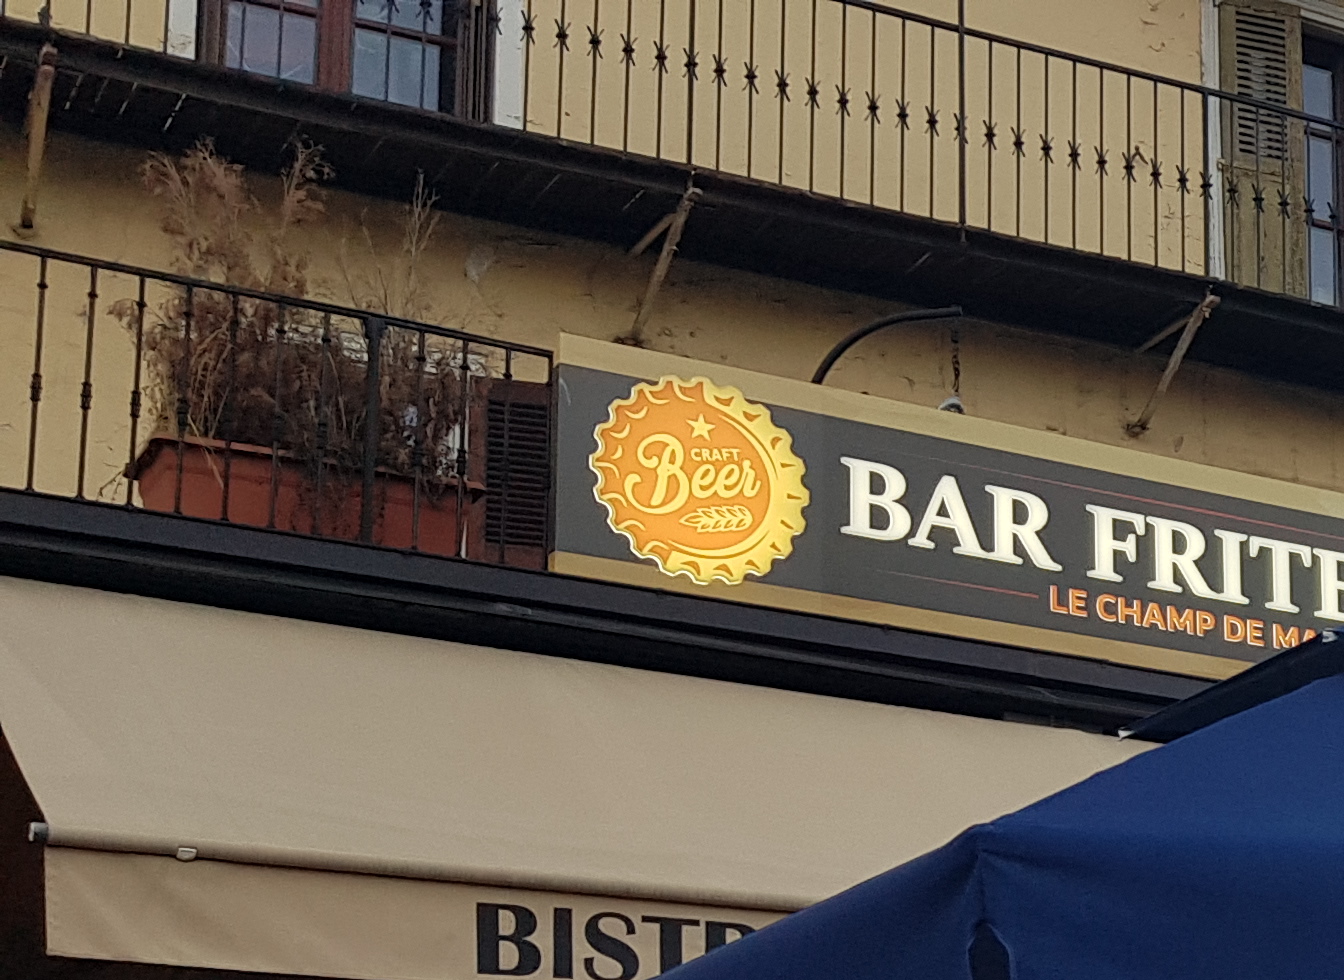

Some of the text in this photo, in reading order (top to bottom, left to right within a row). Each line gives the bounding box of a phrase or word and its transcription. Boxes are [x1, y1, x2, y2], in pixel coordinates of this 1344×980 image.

[623, 433, 762, 515] Beer
[690, 448, 740, 462] CRAFT
[840, 456, 1063, 572] BAR
[1049, 585, 1320, 650] LE CHAMP DE MA
